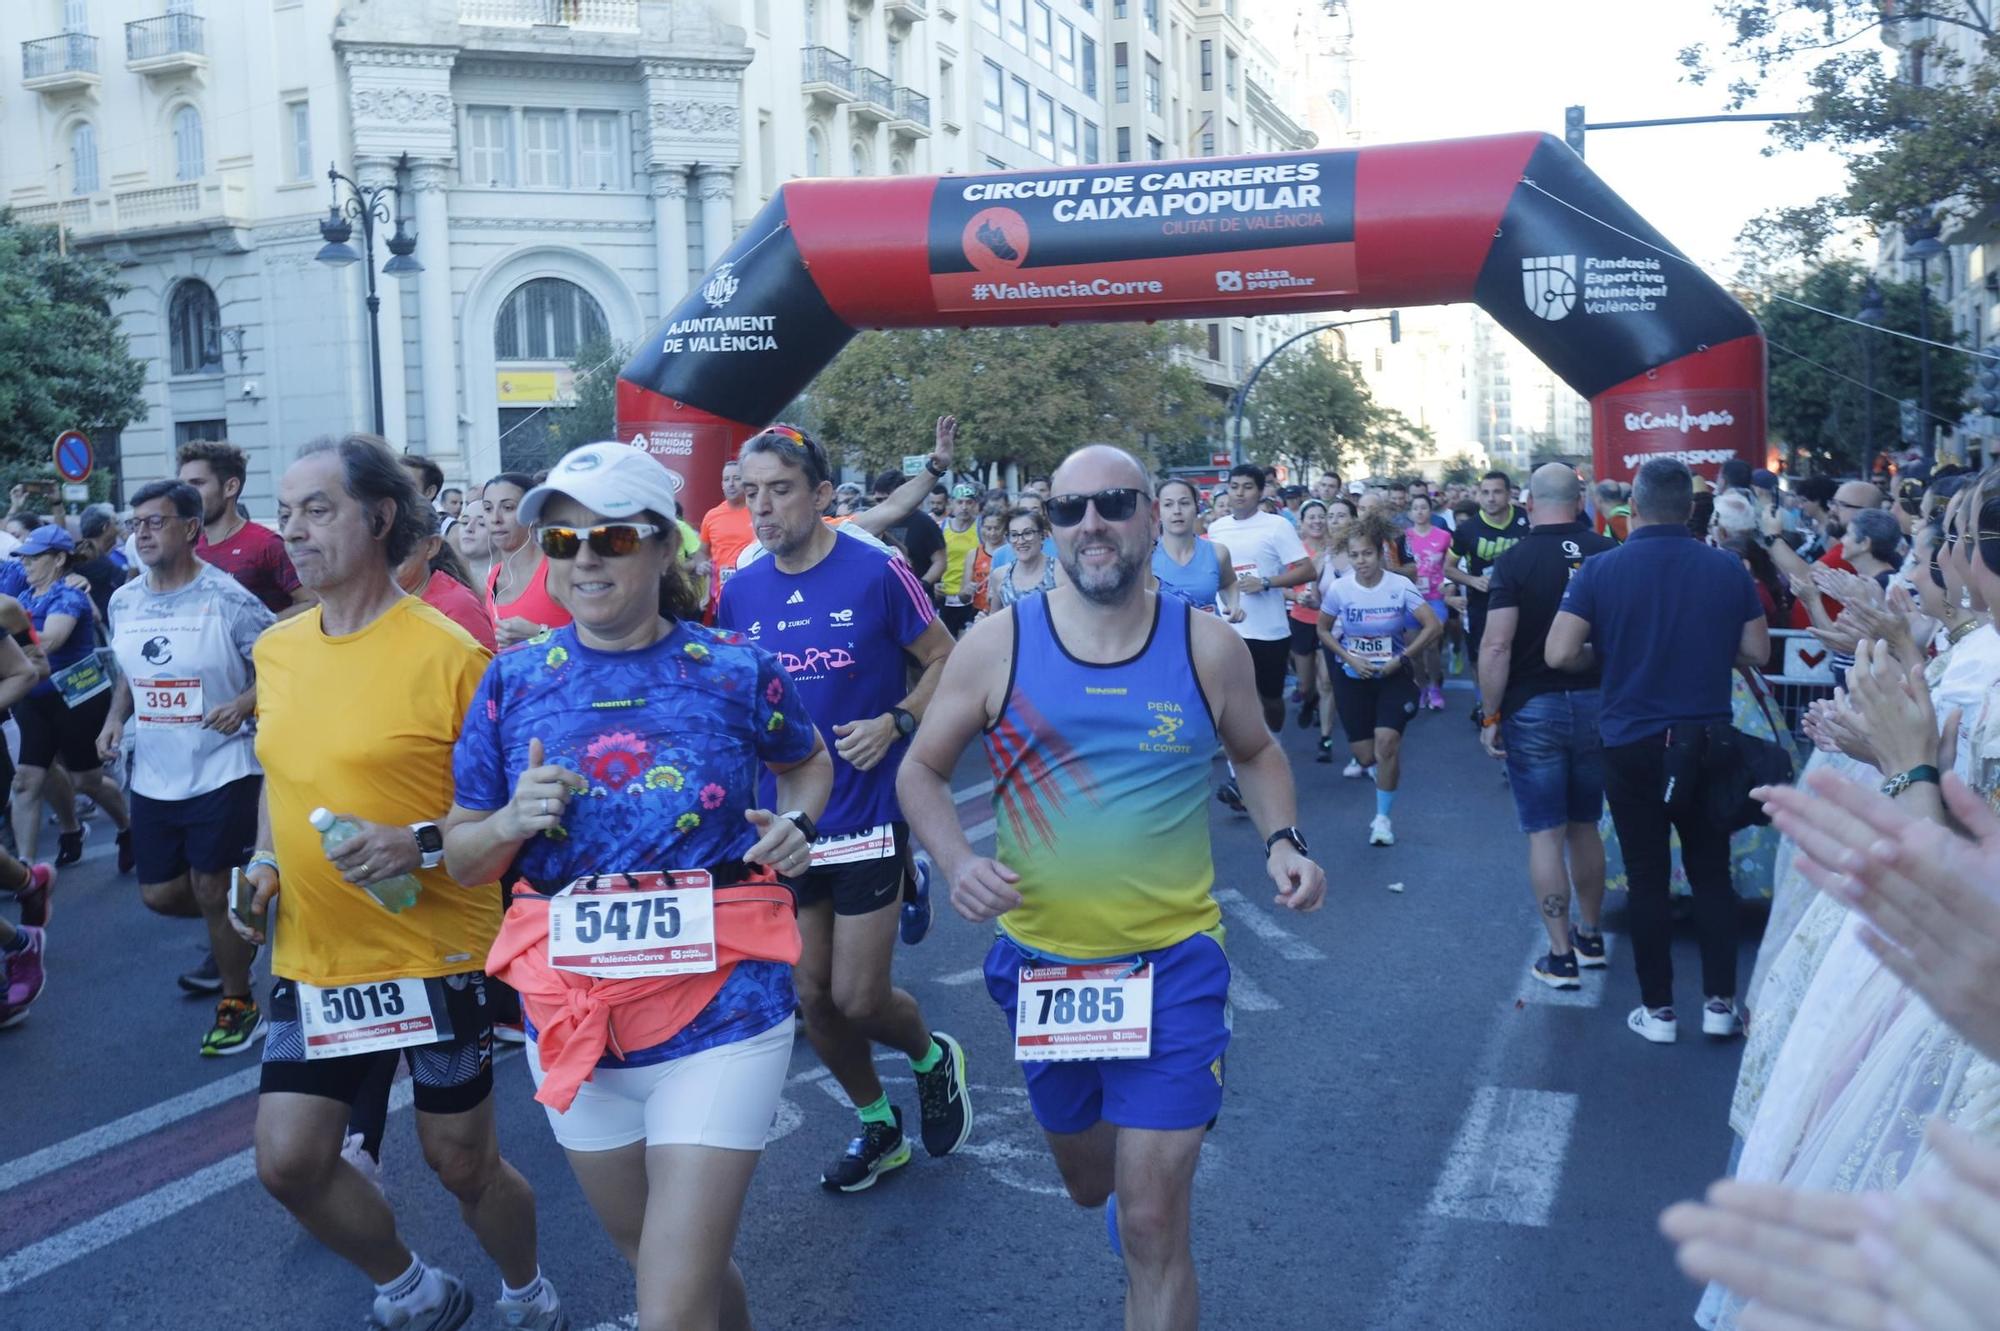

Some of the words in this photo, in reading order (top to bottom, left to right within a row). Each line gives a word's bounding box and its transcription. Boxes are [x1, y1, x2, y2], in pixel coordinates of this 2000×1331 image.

[962, 178, 1086, 201] CIRCUIT
[1091, 176, 1135, 195] DE
[1140, 163, 1320, 192] CARRERES
[1162, 219, 1216, 235] CIUTAT
[1220, 217, 1240, 232] DE
[1245, 211, 1324, 231] VALÈNCIA
[1584, 256, 1661, 270] Fundació
[1245, 268, 1289, 281] caixa
[1584, 272, 1665, 287] Esportiva
[972, 278, 1163, 300] #ValènciaCorre
[1246, 275, 1316, 291] popular
[1584, 285, 1668, 301] Municipal
[1584, 300, 1657, 314] València
[666, 316, 776, 336] AJUNTAMENT
[663, 339, 683, 353] DE
[689, 333, 778, 352] VALÈNCIA
[650, 438, 693, 447] TRINIDAD
[650, 447, 693, 455] ALFONSO
[788, 619, 810, 628] ZURICH
[146, 691, 187, 708] 394
[1147, 700, 1183, 713] PEÑA
[1139, 743, 1151, 752] EL
[1153, 743, 1192, 754] COYOTE
[575, 897, 681, 944] 5475
[590, 953, 665, 964] #ValènciaCorre
[321, 982, 405, 1024] 5013
[1036, 987, 1124, 1025] 7885
